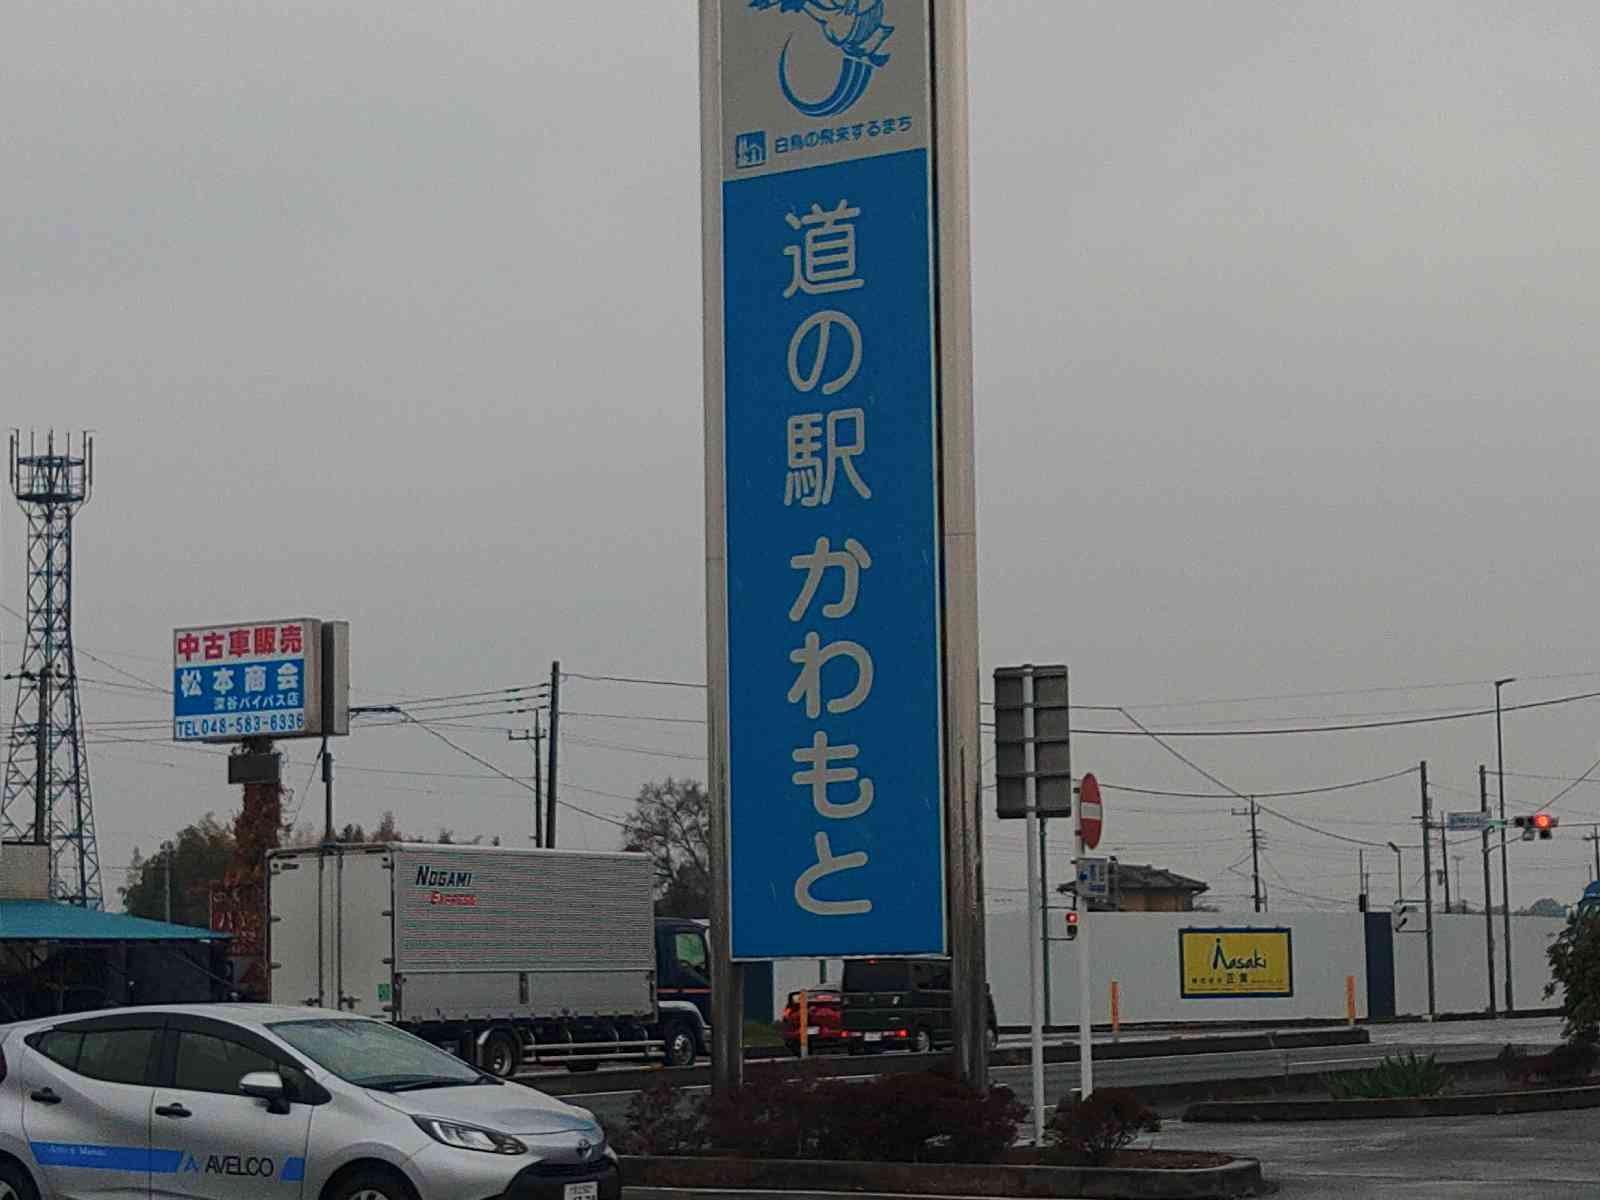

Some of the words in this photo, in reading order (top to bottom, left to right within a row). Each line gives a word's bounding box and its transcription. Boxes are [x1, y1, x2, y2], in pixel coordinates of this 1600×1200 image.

[783, 199, 872, 506] 道の駅
[177, 624, 303, 662] 中古車販売
[180, 662, 299, 698] 松本商会
[787, 536, 874, 916] かわもと
[205, 1155, 274, 1177] AVELCO
